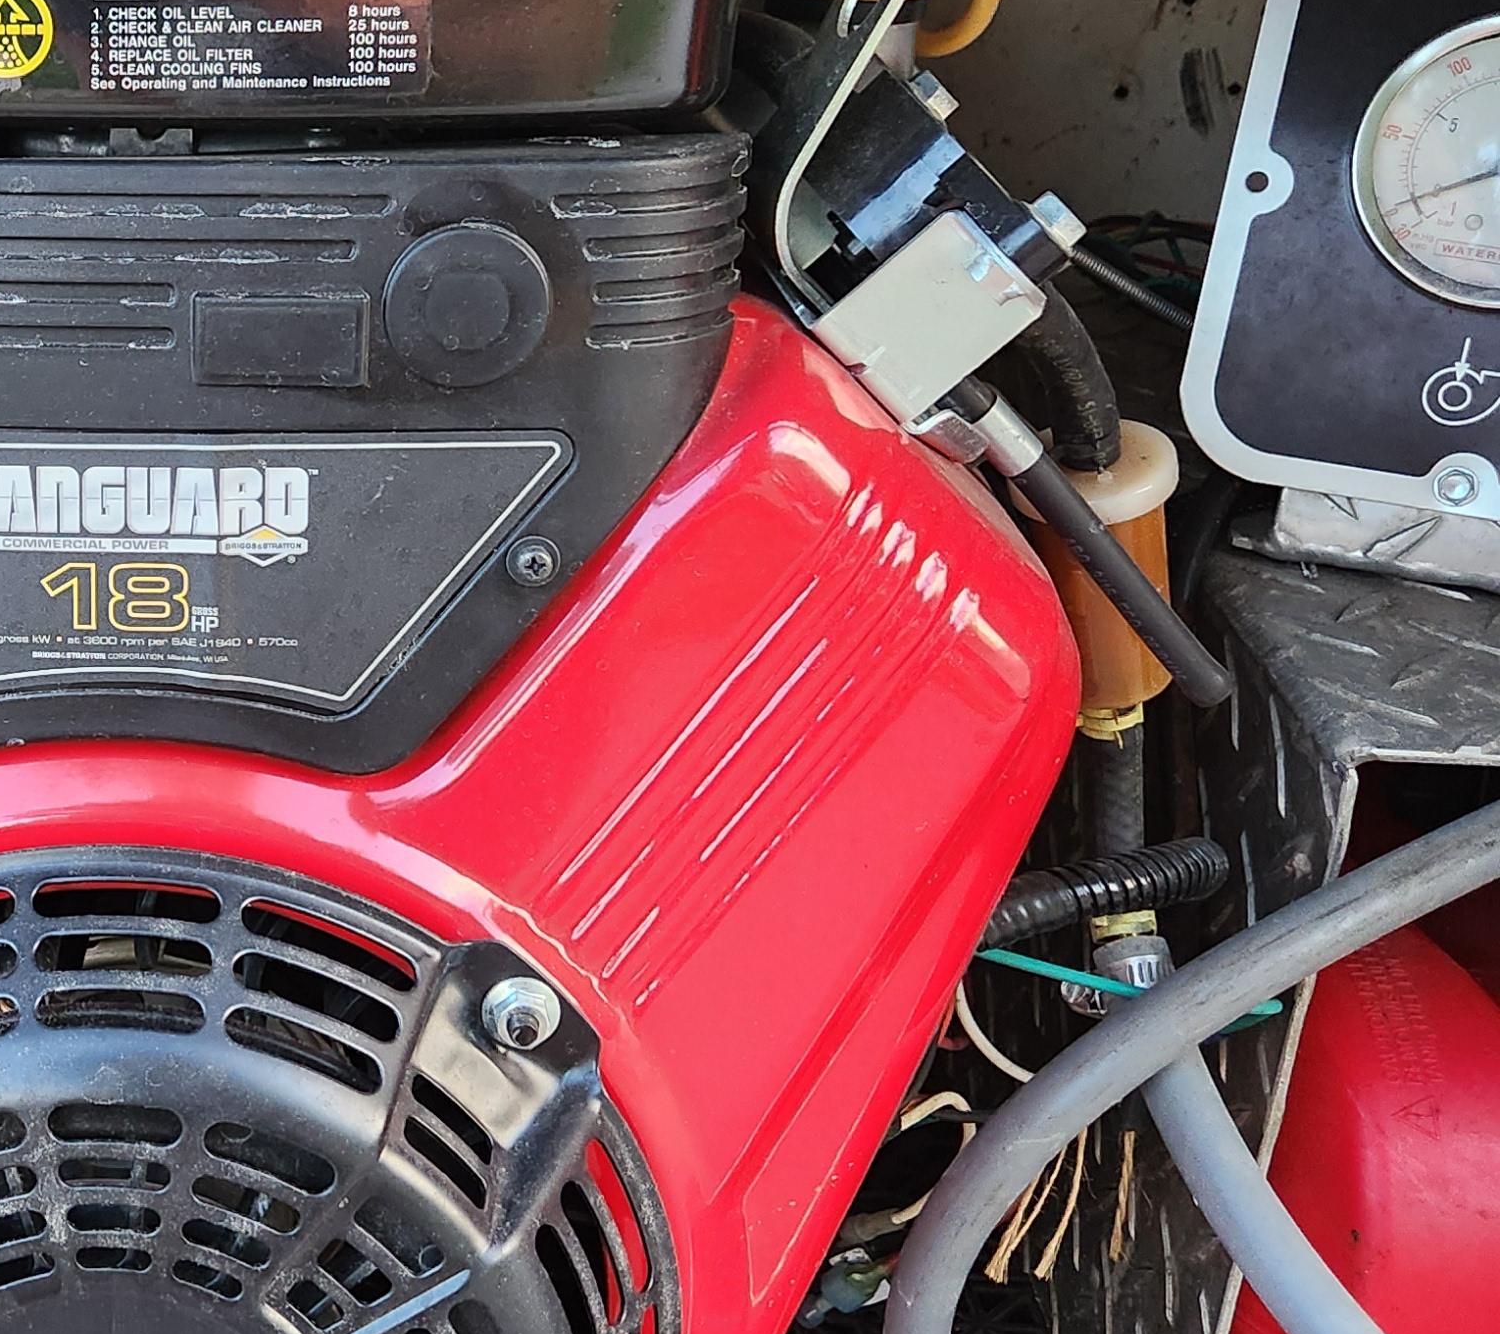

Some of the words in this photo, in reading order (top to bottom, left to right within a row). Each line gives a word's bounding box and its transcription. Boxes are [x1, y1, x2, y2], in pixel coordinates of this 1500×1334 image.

[108, 7, 157, 20] CHECK
[162, 7, 185, 20] OIL
[190, 6, 235, 20] LEVEL
[348, 5, 358, 17] 8
[362, 5, 401, 17] hours
[108, 21, 157, 34] CHECK
[162, 21, 172, 34] &
[176, 21, 223, 33] CLEAN
[228, 20, 251, 33] AIR
[256, 19, 323, 33] CLEANER
[348, 19, 367, 32] 25
[371, 19, 410, 31] hours
[108, 35, 167, 48] CHANGE
[172, 35, 196, 48] OIL
[348, 33, 375, 45] 100
[378, 33, 417, 45] hours
[108, 49, 172, 62] REPLACE
[177, 49, 200, 62] OIL
[205, 48, 253, 62] FILTER
[348, 47, 375, 60] 100
[378, 47, 417, 59] hours
[108, 63, 155, 76] CLEAN
[160, 63, 224, 76] COOLING
[230, 62, 262, 75] FINS
[348, 61, 374, 74] 100
[377, 61, 416, 73] hours
[1447, 57, 1472, 77] 100
[90, 77, 116, 90] See
[121, 77, 187, 92] Operating
[192, 77, 217, 89] and
[222, 76, 308, 89] Maintenance
[313, 75, 391, 88] Instructions
[1449, 117, 1459, 133] 5
[1382, 124, 1402, 141] 50
[1442, 244, 1500, 260] WATER
[2, 538, 106, 549] COMMERCIAL
[111, 539, 169, 550] POWER
[40, 561, 190, 632] 18
[191, 606, 219, 616] GROSS
[191, 616, 219, 633] HP
[32, 634, 51, 644] kW
[67, 636, 80, 644] at
[120, 637, 145, 647] rpm
[148, 638, 168, 647] per
[171, 637, 197, 647] SAE
